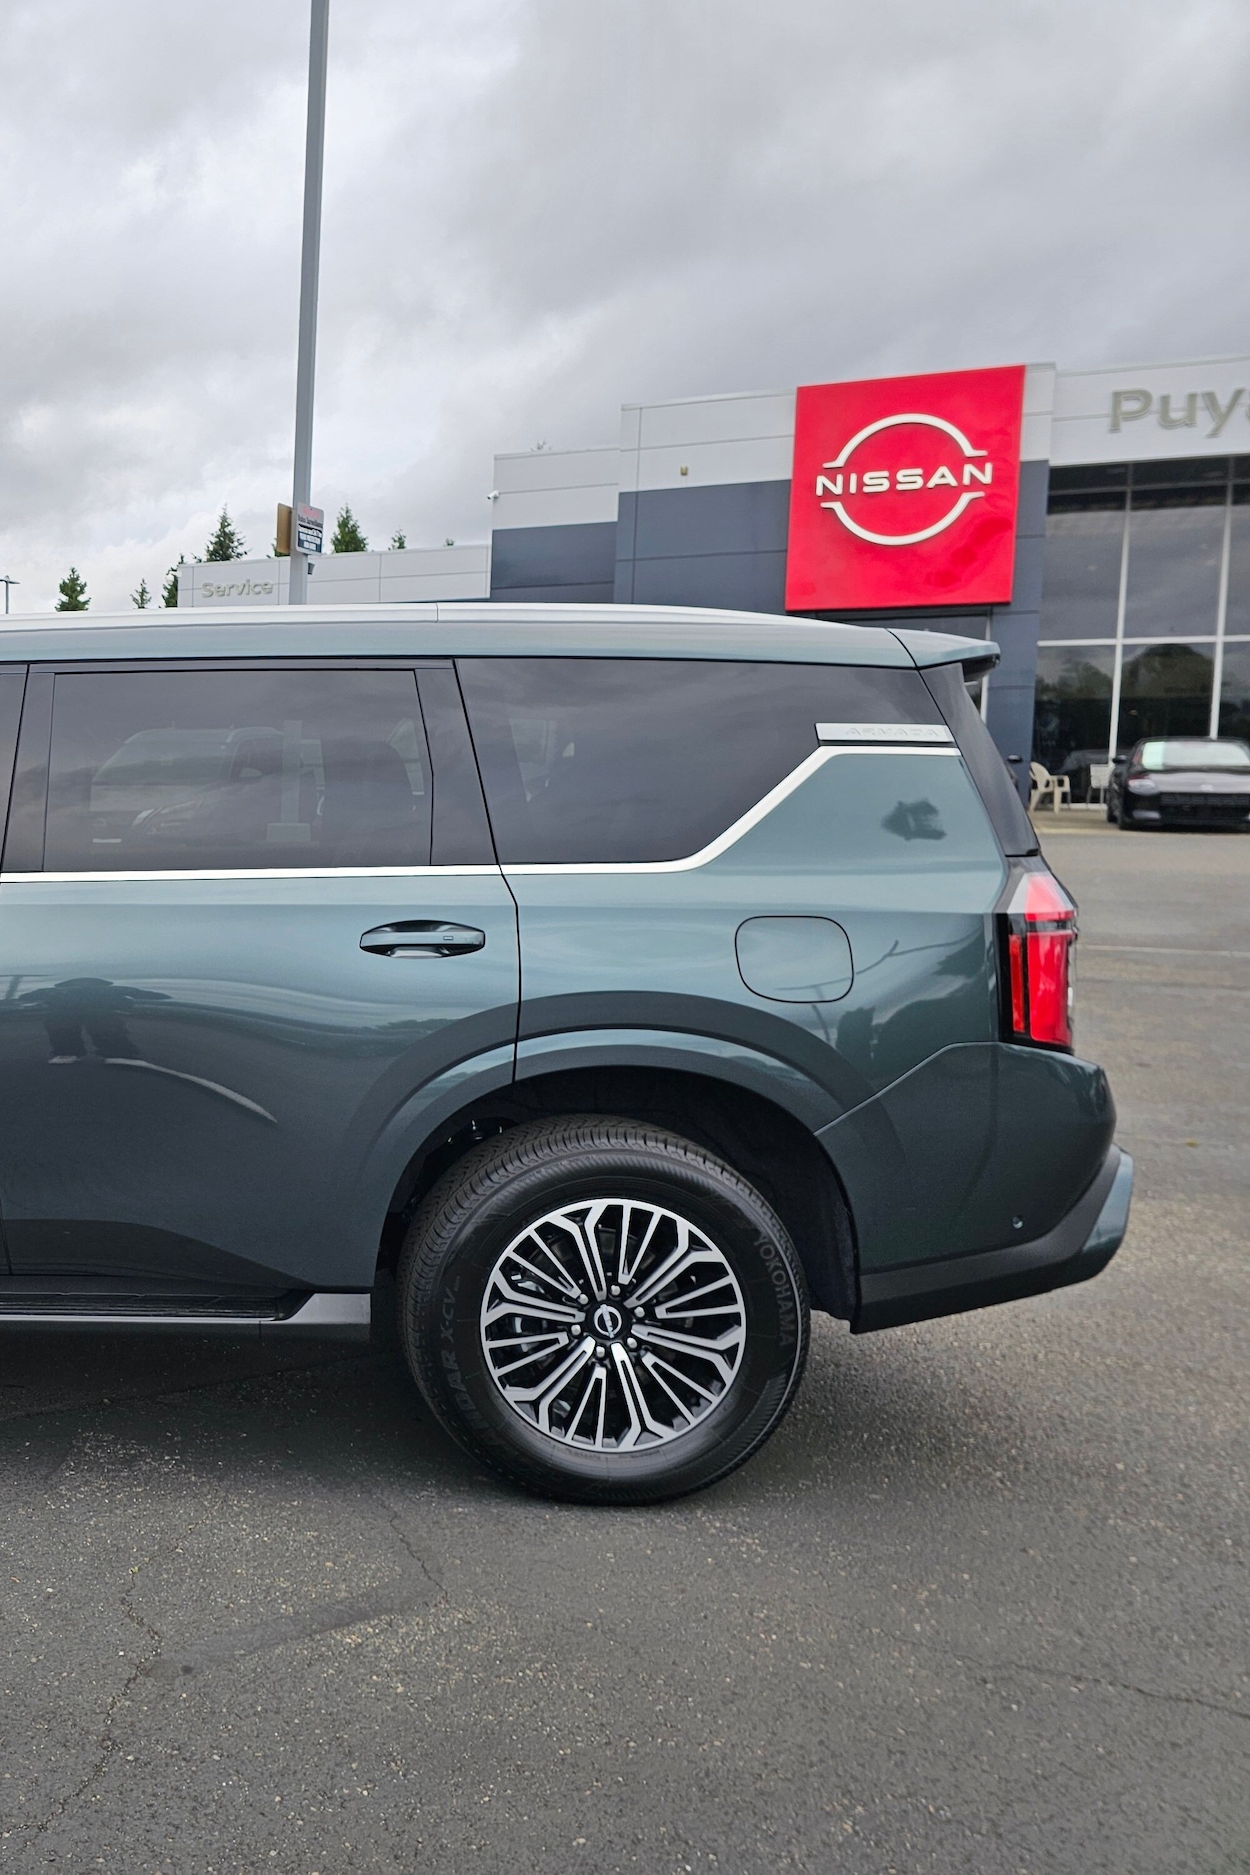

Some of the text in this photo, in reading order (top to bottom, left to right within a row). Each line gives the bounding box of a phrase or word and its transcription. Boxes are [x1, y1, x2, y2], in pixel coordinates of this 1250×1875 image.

[1109, 386, 1250, 439] Puy
[815, 462, 994, 497] NISSAN
[201, 579, 273, 598] Service
[844, 727, 940, 738] ARMADA
[753, 1229, 795, 1346] YOKOHAMA
